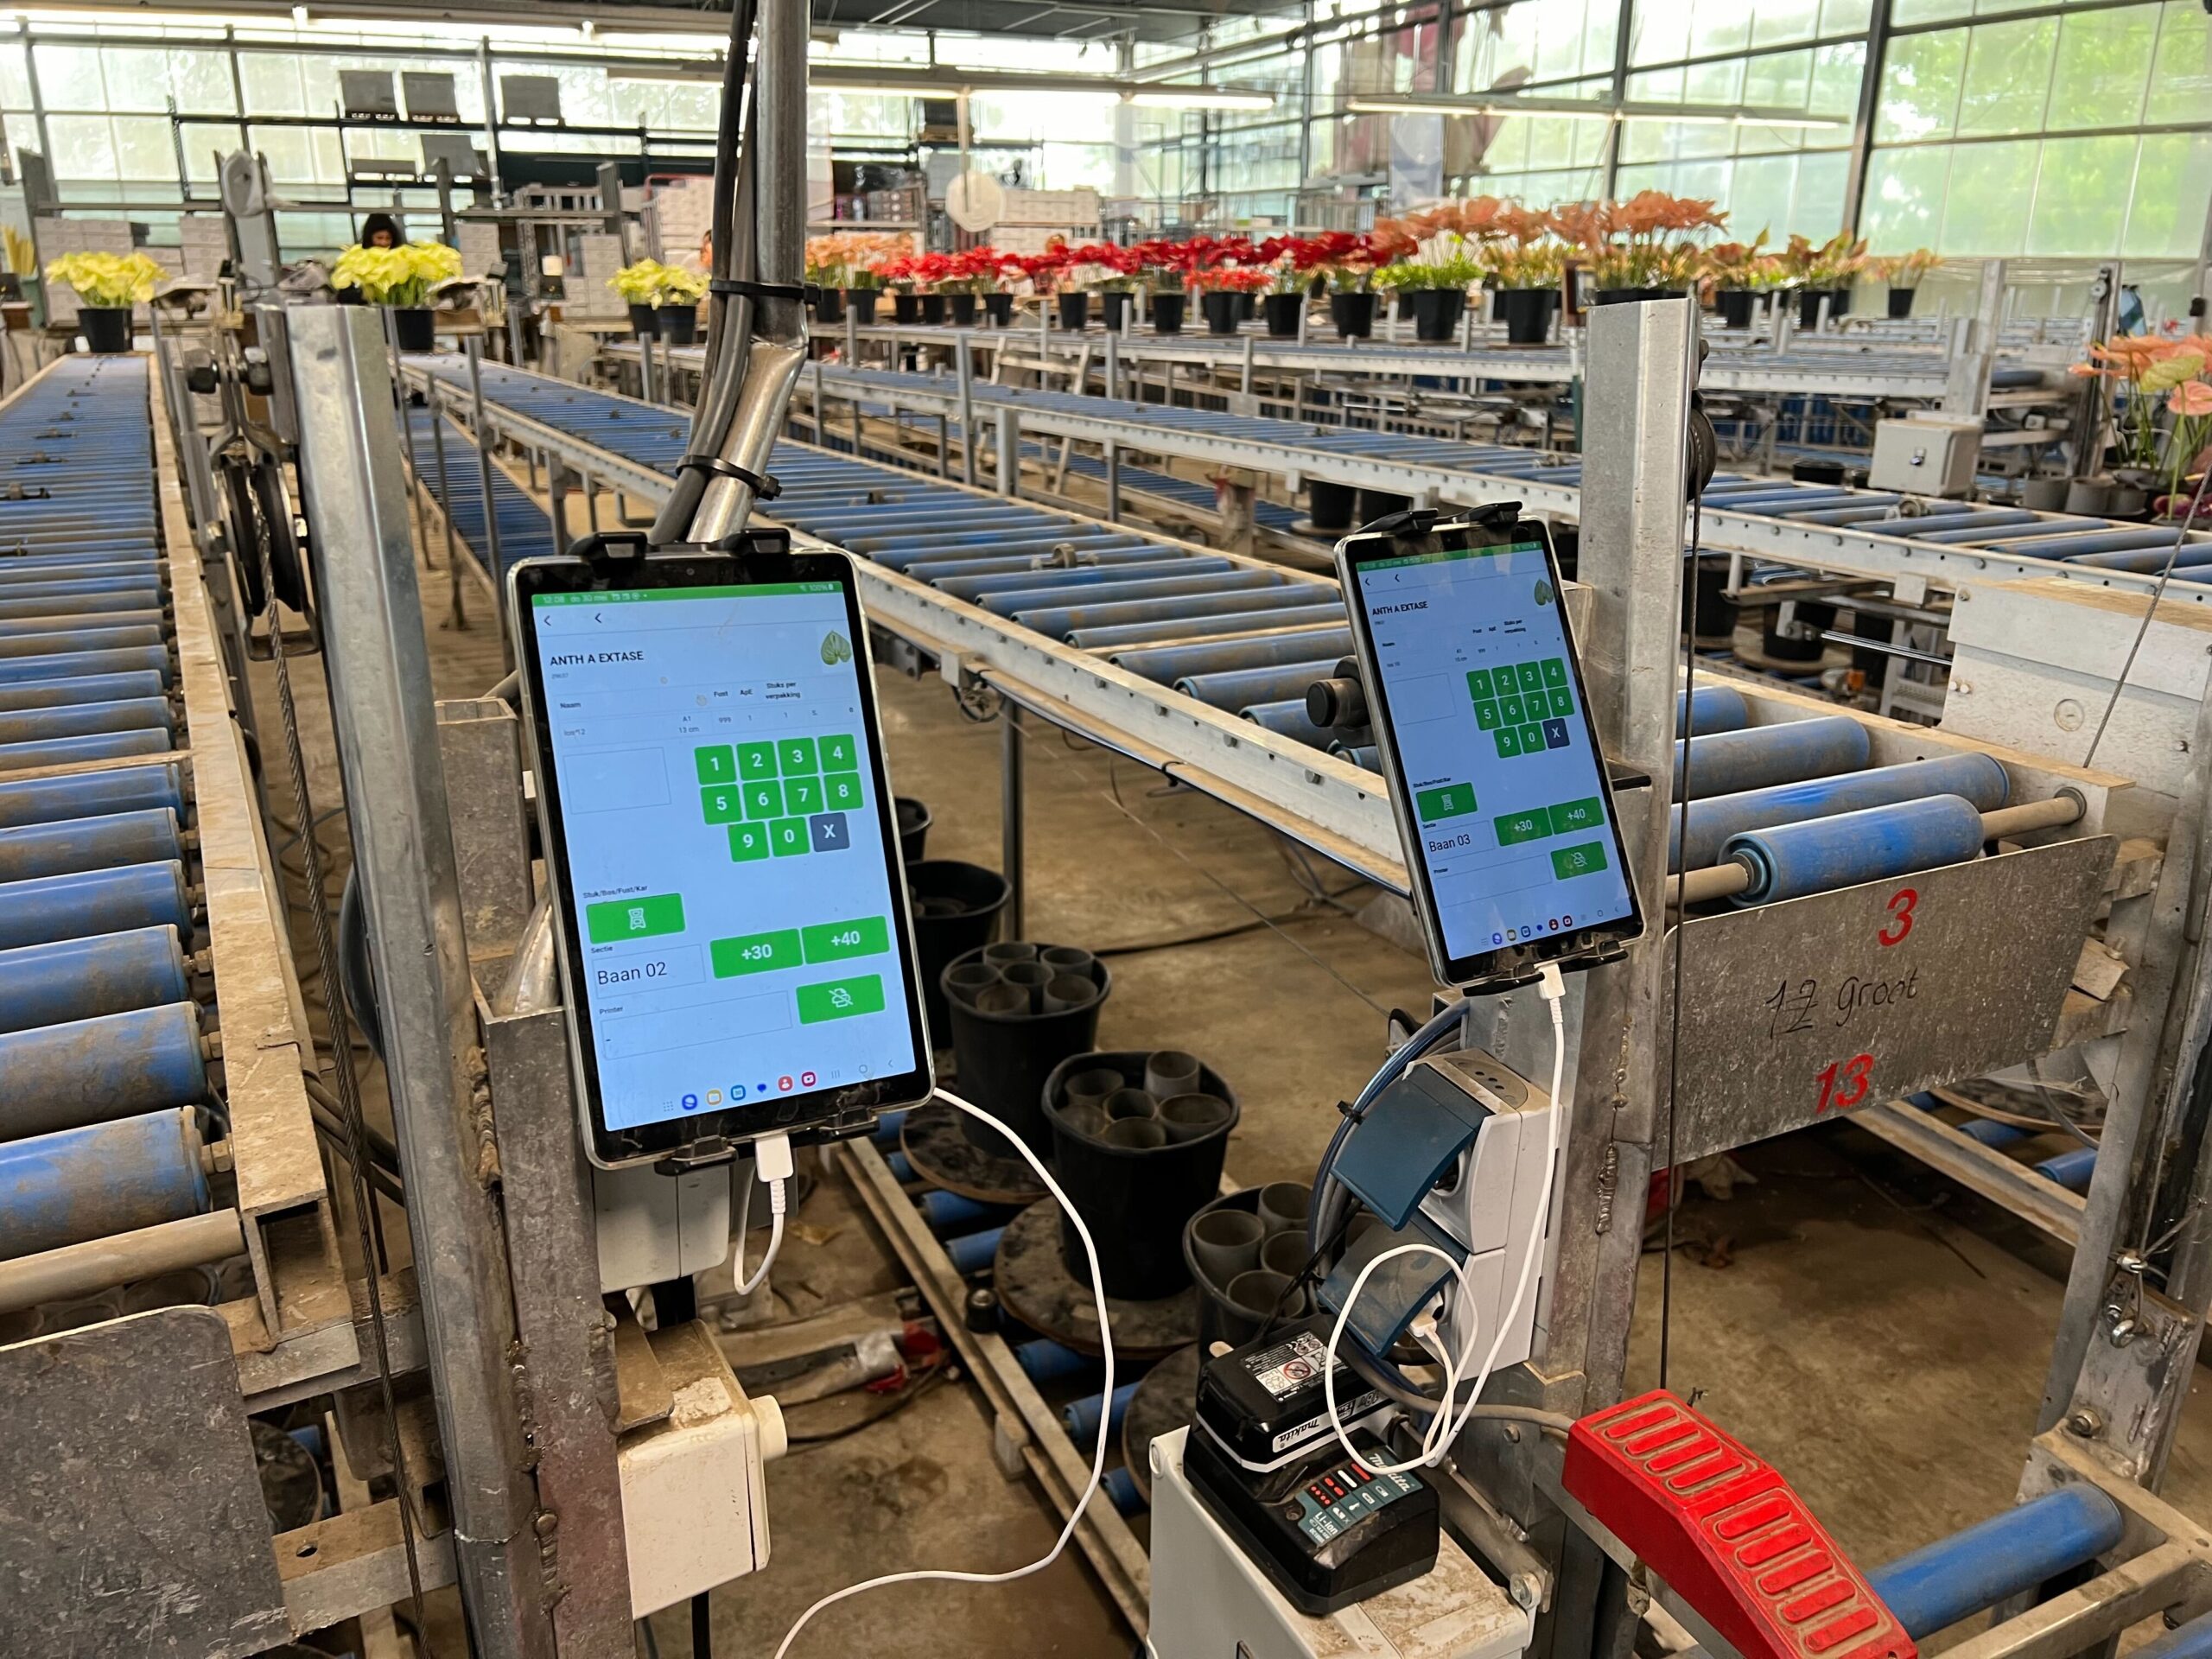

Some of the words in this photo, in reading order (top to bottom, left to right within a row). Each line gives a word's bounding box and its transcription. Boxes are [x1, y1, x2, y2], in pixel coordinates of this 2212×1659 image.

[1372, 606, 1393, 615] ANTH
[1400, 601, 1428, 612] EXTASE
[550, 654, 585, 667] ANTH
[588, 653, 597, 664] A
[598, 651, 645, 664] EXTASE
[1477, 679, 1484, 690] 1
[1502, 675, 1510, 686] 2
[1526, 671, 1534, 682] 3
[1550, 667, 1558, 677] 4
[1484, 709, 1491, 720] 5
[1509, 704, 1516, 715] 6
[1533, 701, 1540, 711] 7
[1557, 696, 1564, 707] 8
[1503, 736, 1510, 747] 9
[1528, 732, 1535, 742] 0
[1552, 728, 1560, 738] X
[710, 757, 719, 771] 1
[752, 753, 763, 767] 2
[792, 749, 803, 763] 3
[833, 746, 843, 760] 4
[716, 796, 728, 810] 5
[758, 792, 769, 806] 6
[798, 788, 808, 802] 7
[838, 784, 849, 798] 8
[1567, 808, 1586, 820] +40
[742, 834, 753, 848] 9
[784, 829, 795, 843] 0
[823, 823, 836, 839] X
[1514, 820, 1533, 832] +30
[1428, 839, 1456, 852] Baan
[1457, 834, 1471, 846] 03
[1878, 887, 1918, 948] 3
[830, 931, 861, 946] +40
[741, 944, 772, 960] +30
[596, 968, 641, 986] Baan
[645, 961, 668, 978] 02
[1815, 1052, 1875, 1116] 13
[1278, 1418, 1320, 1442] makita
[1369, 1452, 1411, 1492] mita
